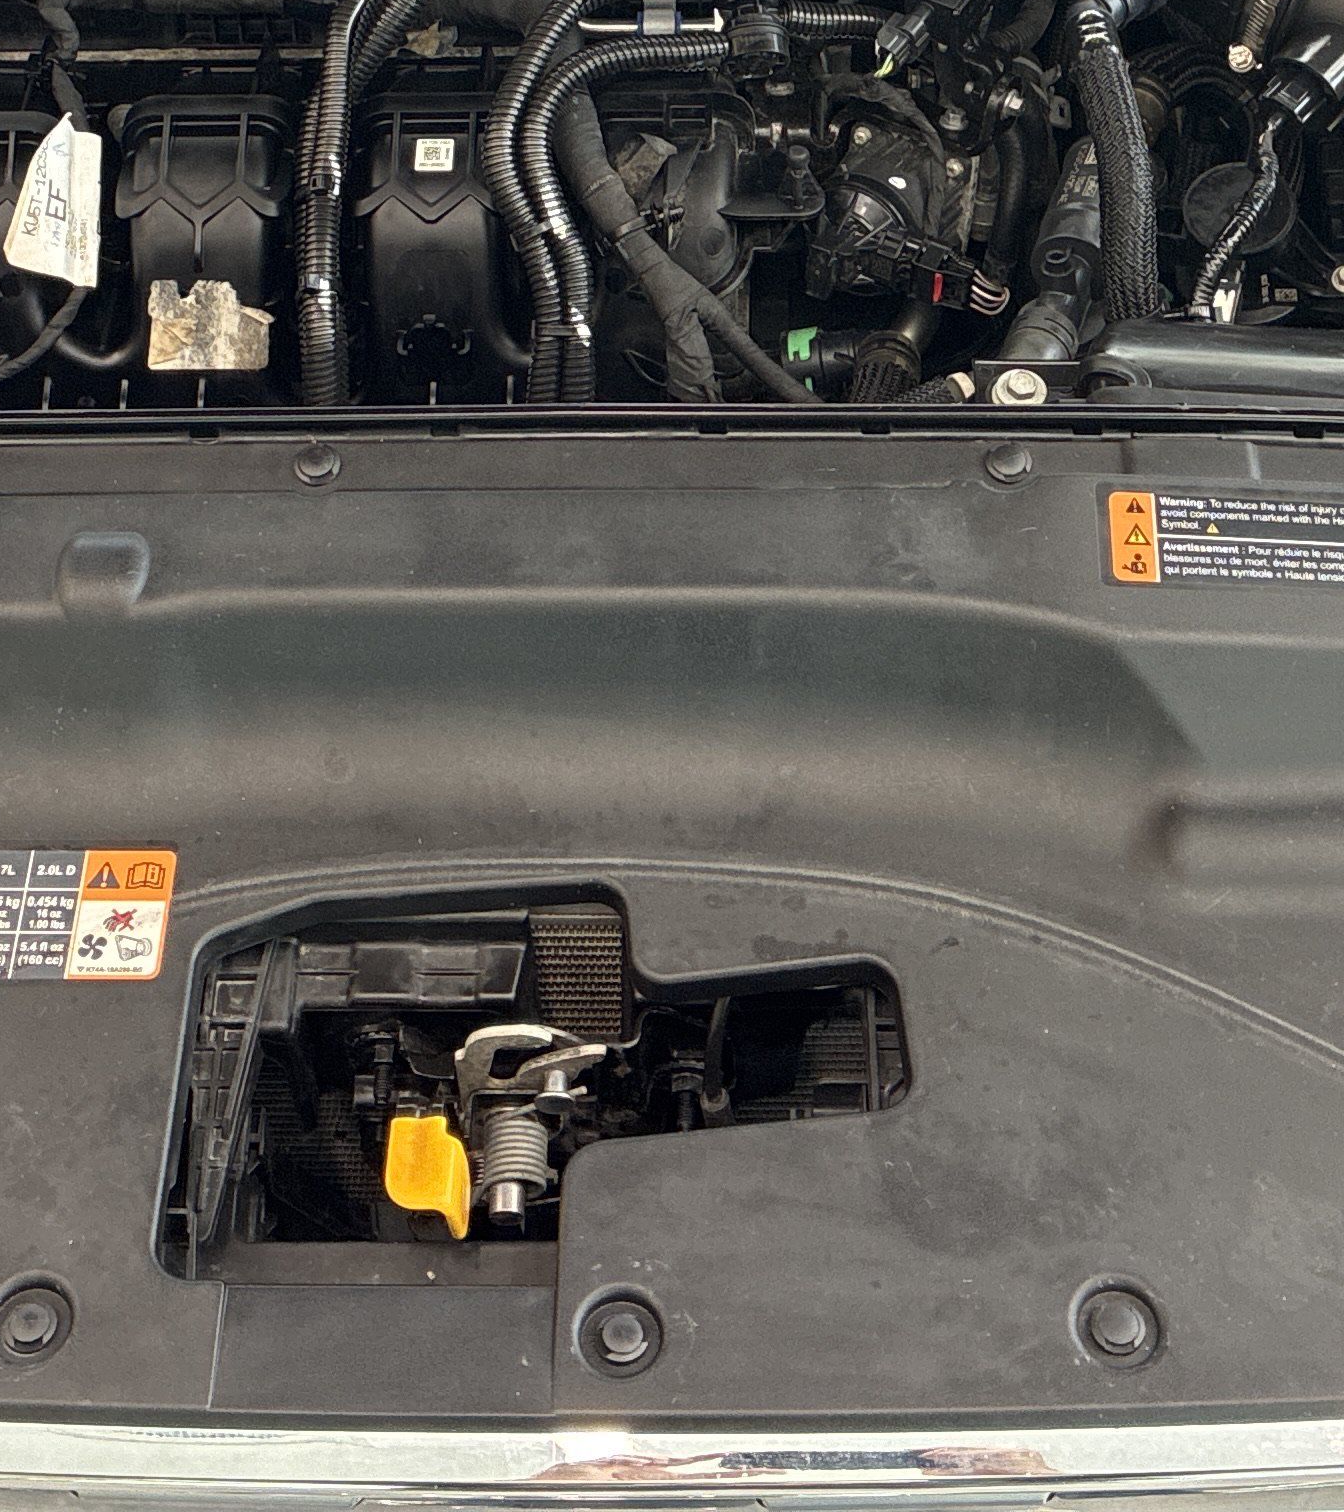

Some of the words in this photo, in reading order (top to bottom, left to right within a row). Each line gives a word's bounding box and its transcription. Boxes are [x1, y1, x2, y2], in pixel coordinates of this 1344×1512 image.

[1160, 497, 1206, 511] Warning:
[1210, 500, 1221, 509] To
[1224, 501, 1258, 511] reduce
[1260, 502, 1275, 512] the
[1278, 504, 1296, 513] risk
[1298, 505, 1308, 513] of
[1311, 505, 1337, 518] injury
[1160, 509, 1187, 518] avoid
[1190, 512, 1249, 522] components
[1253, 514, 1289, 523] marked
[1292, 515, 1312, 524] with
[1314, 516, 1330, 525] the
[1161, 519, 1201, 530] Symbol.
[1163, 541, 1239, 554] Avertissement
[1248, 546, 1271, 556] Pour
[1275, 547, 1309, 557] réduire
[1312, 549, 1320, 558] le
[1163, 553, 1211, 564] blessures
[1230, 557, 1243, 566] de
[1273, 559, 1299, 569] éviter
[1303, 560, 1317, 570] les
[1165, 565, 1179, 576] qui
[1183, 566, 1217, 577] portent
[1220, 567, 1228, 576] le
[1232, 568, 1273, 579] symbole
[1285, 570, 1313, 580] Haute
[36, 865, 63, 876] 2.0L
[66, 865, 76, 875] D
[6, 896, 20, 909] kg
[27, 896, 58, 907] 0.454
[60, 896, 75, 910] kg
[36, 909, 48, 918] 16
[29, 920, 49, 929] 1.00
[50, 920, 66, 929] lbs
[20, 941, 37, 952] 5.4
[39, 941, 48, 951] fl
[50, 943, 64, 952] oz
[18, 954, 43, 966] (160
[45, 955, 64, 967] cc)
